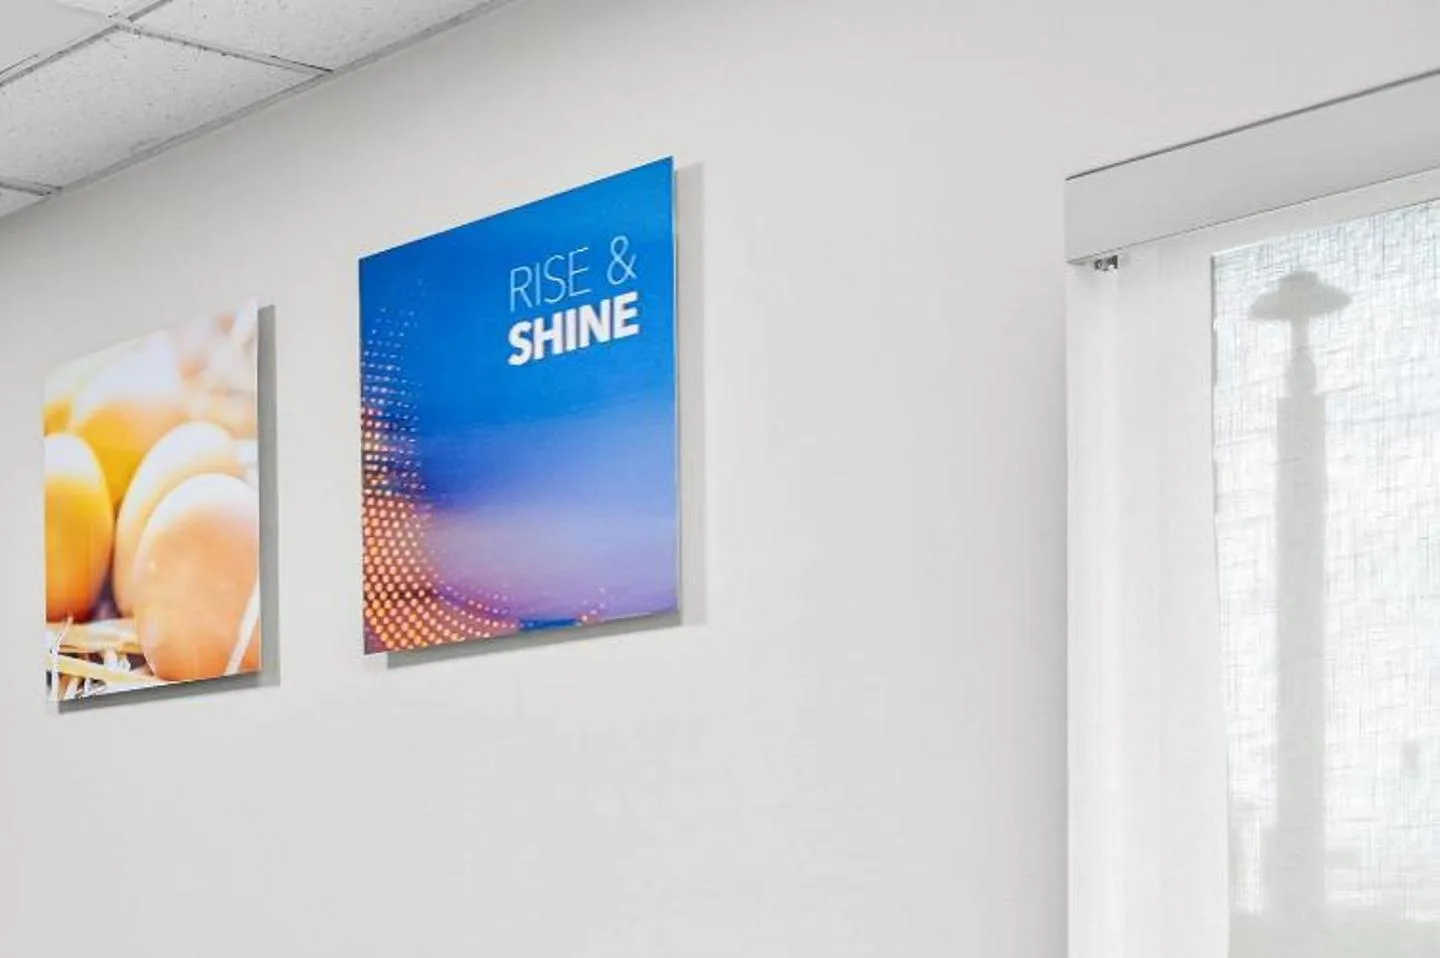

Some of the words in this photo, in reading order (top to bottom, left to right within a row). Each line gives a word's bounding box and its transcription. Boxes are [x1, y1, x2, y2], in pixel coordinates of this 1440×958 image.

[510, 247, 591, 312] RISE
[607, 235, 637, 285] &
[508, 291, 639, 366] SHINE
